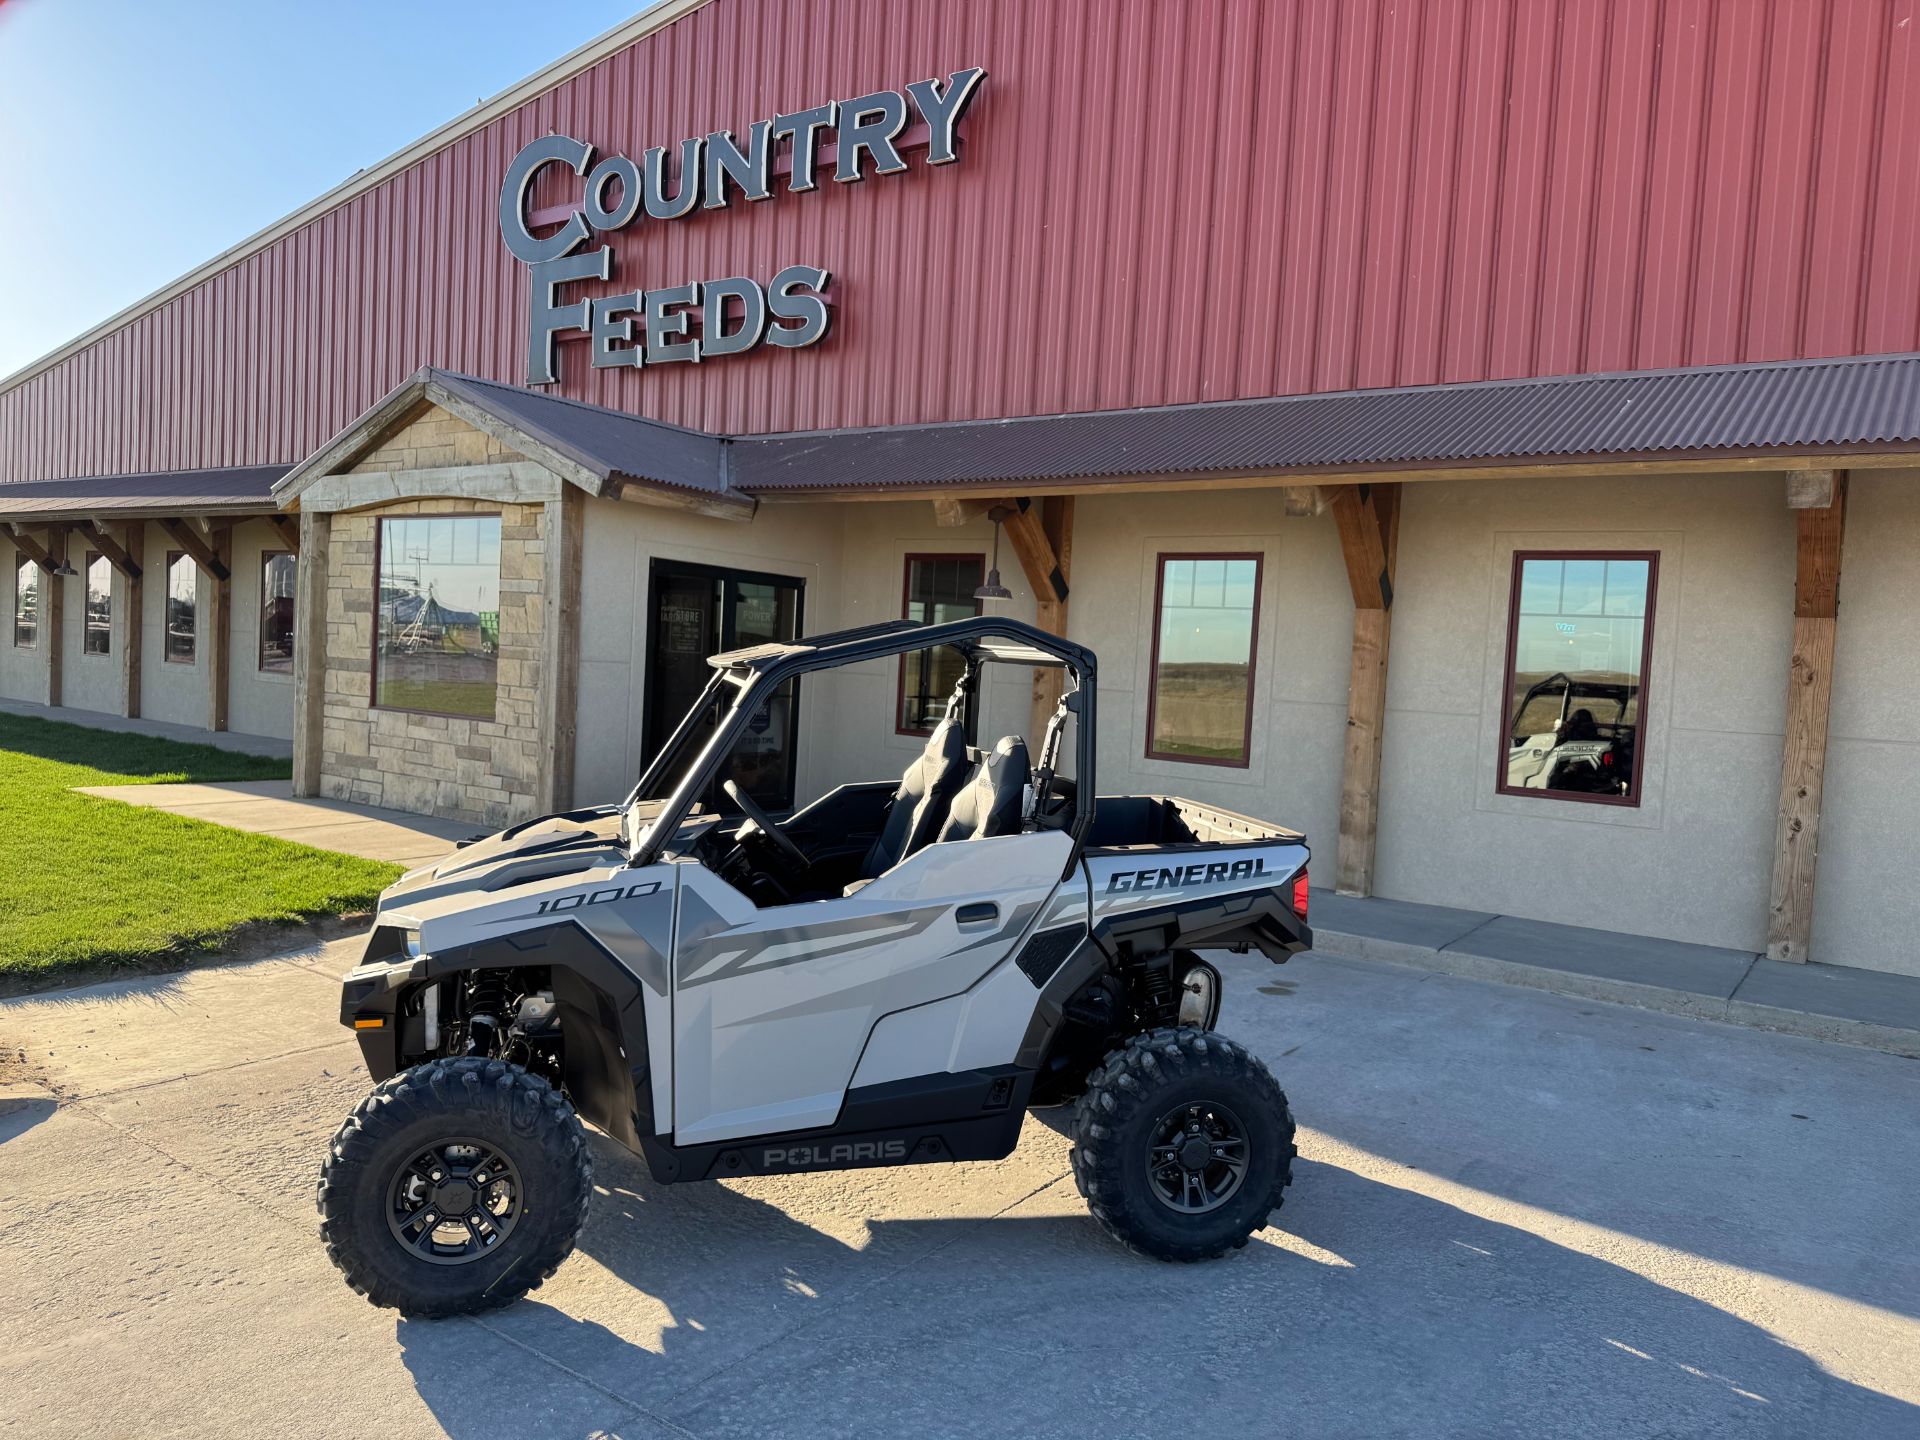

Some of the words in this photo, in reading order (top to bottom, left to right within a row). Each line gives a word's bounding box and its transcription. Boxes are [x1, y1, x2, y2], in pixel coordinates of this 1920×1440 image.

[499, 66, 988, 265] COUNTRY
[525, 244, 832, 385] FEEDS
[1105, 857, 1272, 895] GENERAL
[537, 881, 662, 915] 1000
[763, 1139, 906, 1168] POLARIS
